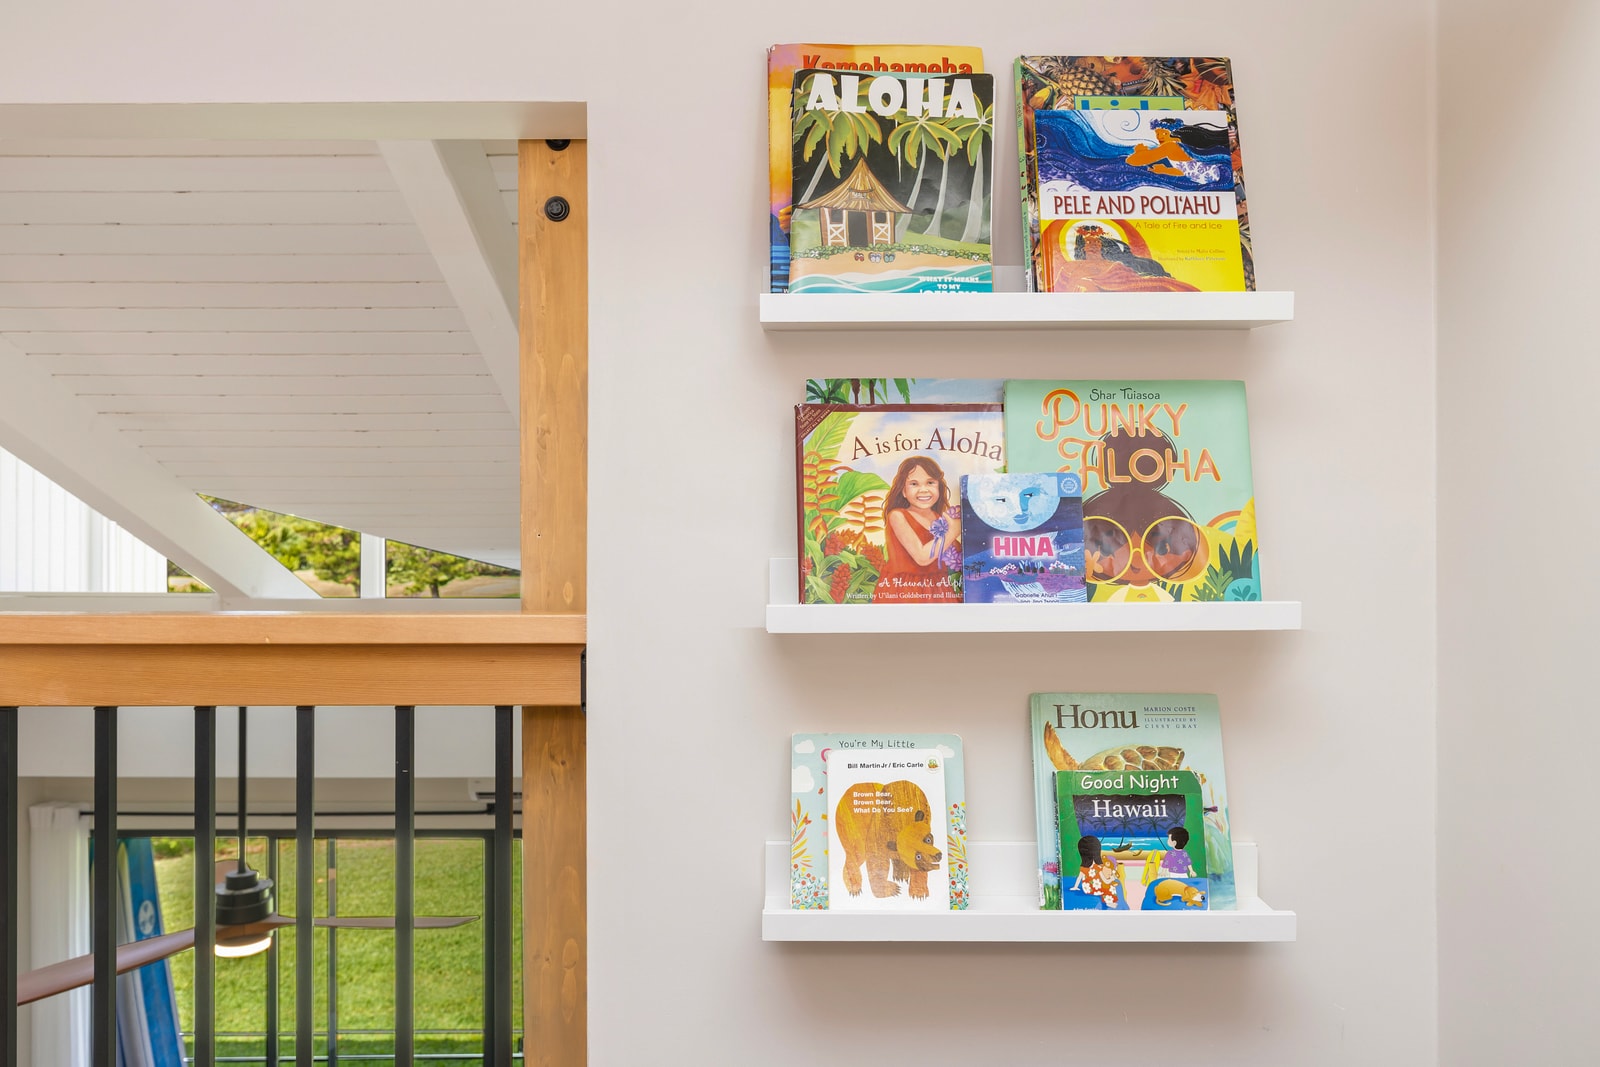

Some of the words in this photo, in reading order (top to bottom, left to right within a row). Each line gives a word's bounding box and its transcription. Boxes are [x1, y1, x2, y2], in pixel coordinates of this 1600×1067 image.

[806, 73, 978, 118] ALOHA
[1054, 196, 1091, 214] PELE
[1096, 196, 1135, 214] AND
[1090, 388, 1116, 401] Shar
[1120, 388, 1160, 400] Tuiasoa
[1036, 388, 1188, 440] PUNKY
[852, 436, 873, 460] A
[875, 437, 890, 454] is
[894, 434, 921, 451] for
[926, 428, 1002, 461] Aloha
[1056, 437, 1222, 494] ALOHA
[994, 536, 1054, 556] HINA
[878, 578, 890, 587] A
[870, 592, 877, 600] by
[900, 591, 931, 600] Goldsberry
[1053, 704, 1140, 728] Honu
[839, 740, 867, 748] You're
[871, 740, 883, 749] My
[887, 740, 915, 748] Little
[1081, 774, 1124, 790] Good
[1130, 774, 1179, 793] Night
[1092, 799, 1168, 818] Hawaii
